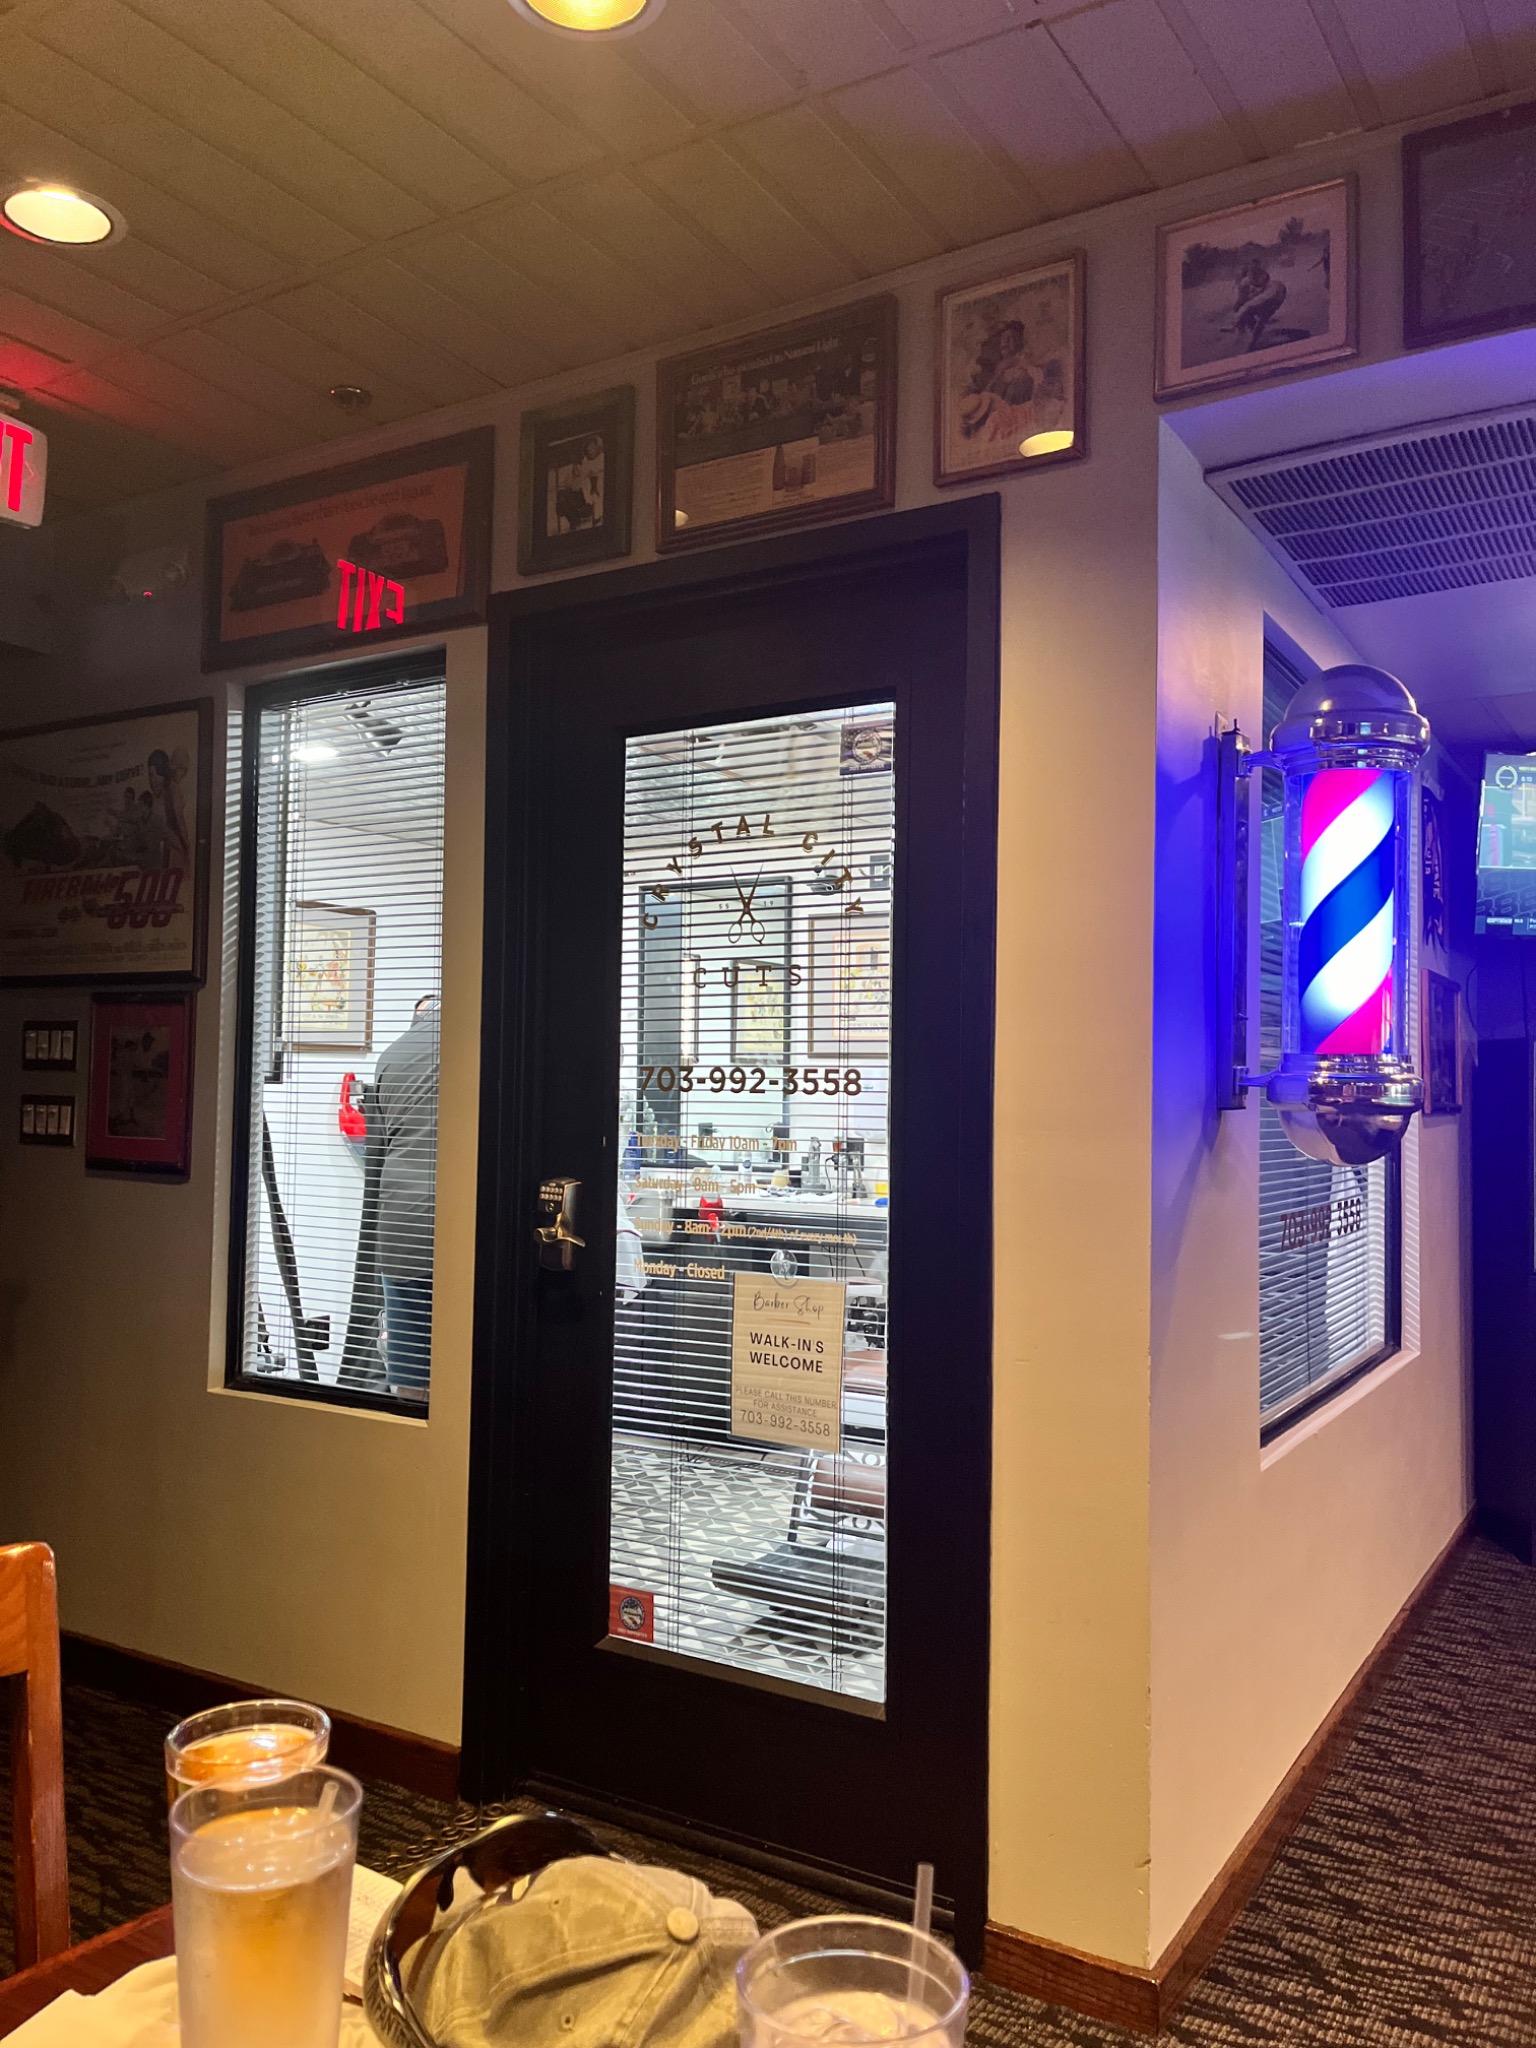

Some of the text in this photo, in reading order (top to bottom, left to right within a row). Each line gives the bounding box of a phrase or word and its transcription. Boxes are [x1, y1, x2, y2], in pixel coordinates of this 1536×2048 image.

[642, 814, 864, 930] CRYSTAL CITY
[693, 964, 802, 989] CUTS
[640, 1066, 862, 1096] 703-992-3558
[729, 1136, 760, 1150] 10am
[634, 1175, 682, 1192] Saturday
[685, 1219, 709, 1233] 8am
[634, 1258, 676, 1277] Monday
[686, 1262, 725, 1280] Closed
[753, 1290, 790, 1310] Barber
[750, 1351, 823, 1373] WELCOME
[735, 1385, 762, 1398] PLEASE
[764, 1390, 783, 1401] CALL
[786, 1393, 802, 1404] THIS
[753, 1400, 818, 1418] FOR ASSISTANCE
[740, 1409, 830, 1437] 703-992-3558
